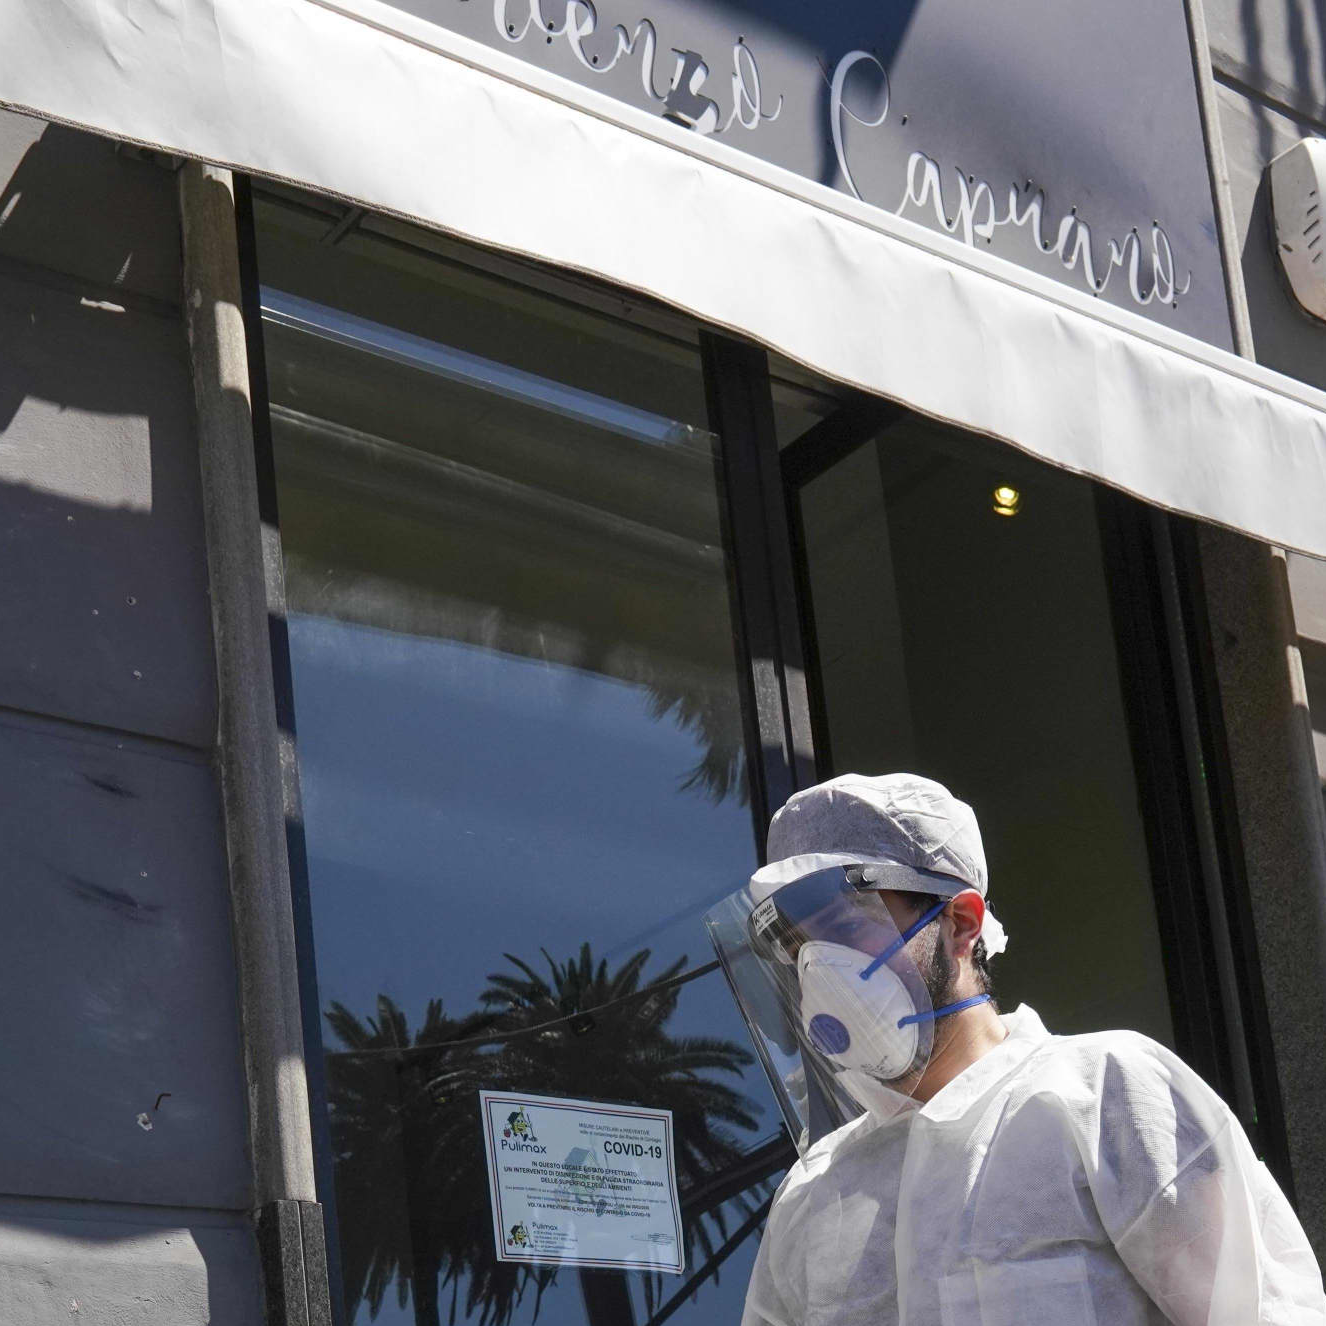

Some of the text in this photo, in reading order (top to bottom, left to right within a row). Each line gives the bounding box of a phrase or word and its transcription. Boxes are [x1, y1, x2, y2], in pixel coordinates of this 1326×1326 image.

[816, 50, 1192, 304] Capuano
[501, 1139, 547, 1154] Pulimax
[604, 1140, 662, 1159] COVID-19
[514, 1167, 548, 1176] INTERVENTO
